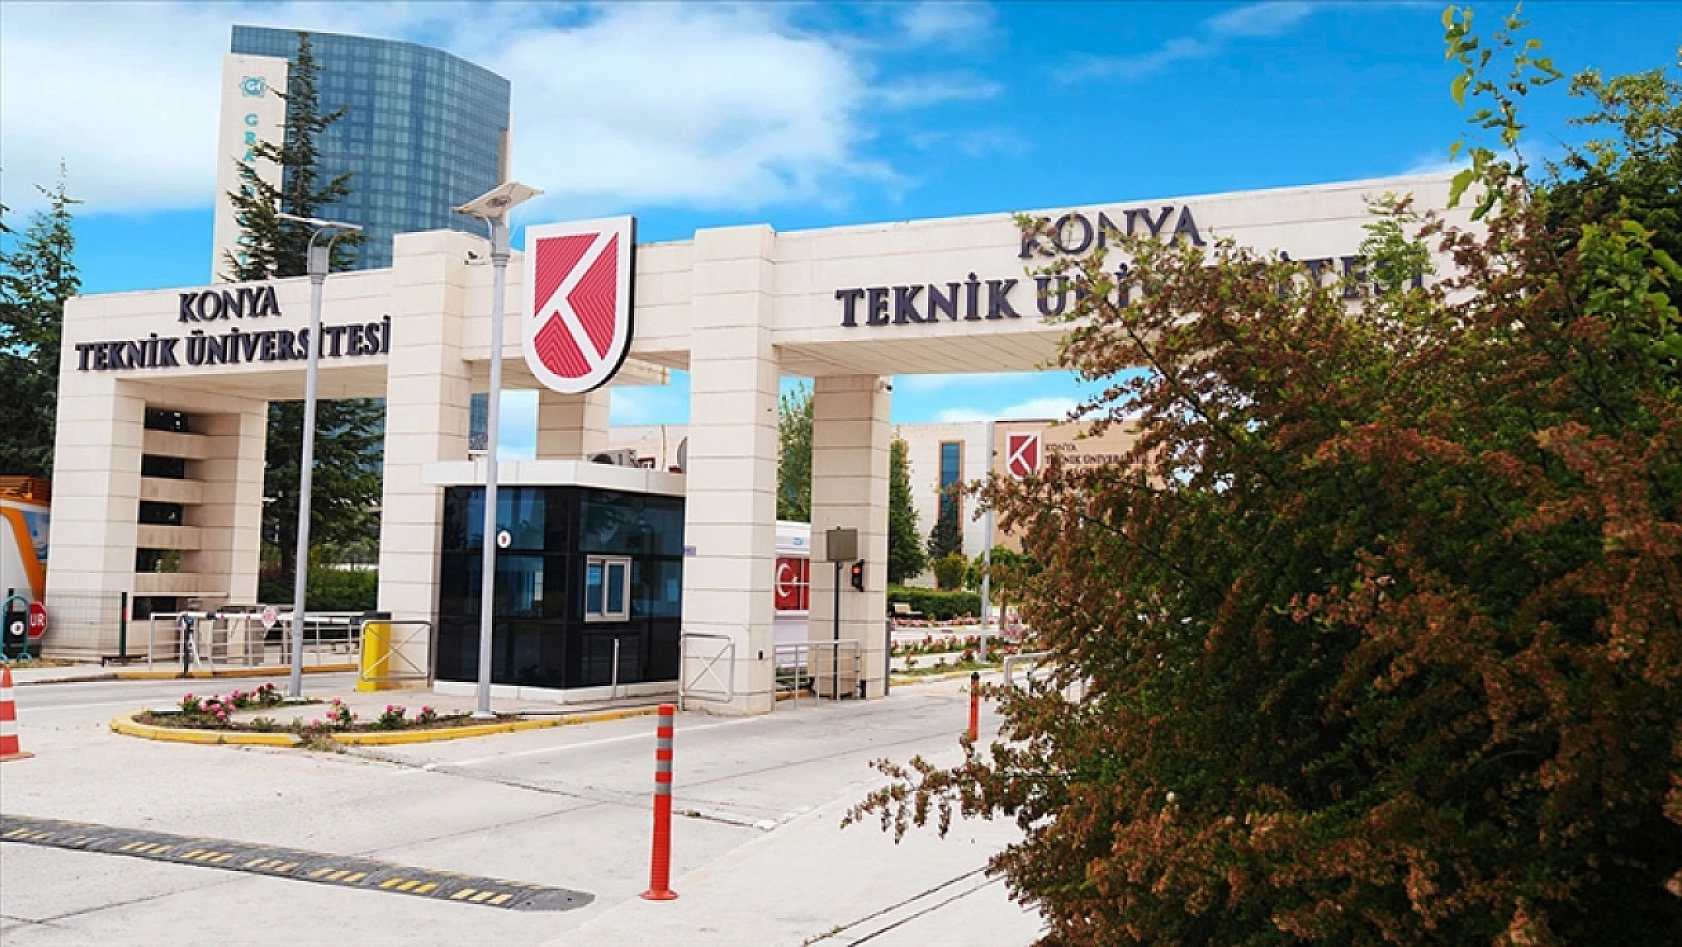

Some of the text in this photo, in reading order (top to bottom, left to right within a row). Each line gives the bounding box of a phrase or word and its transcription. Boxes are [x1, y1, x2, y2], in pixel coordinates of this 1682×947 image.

[1018, 204, 1207, 257] KONYA
[178, 285, 282, 323] KONYA
[834, 271, 1022, 327] TEKNİK
[75, 332, 181, 371] TEKNİK
